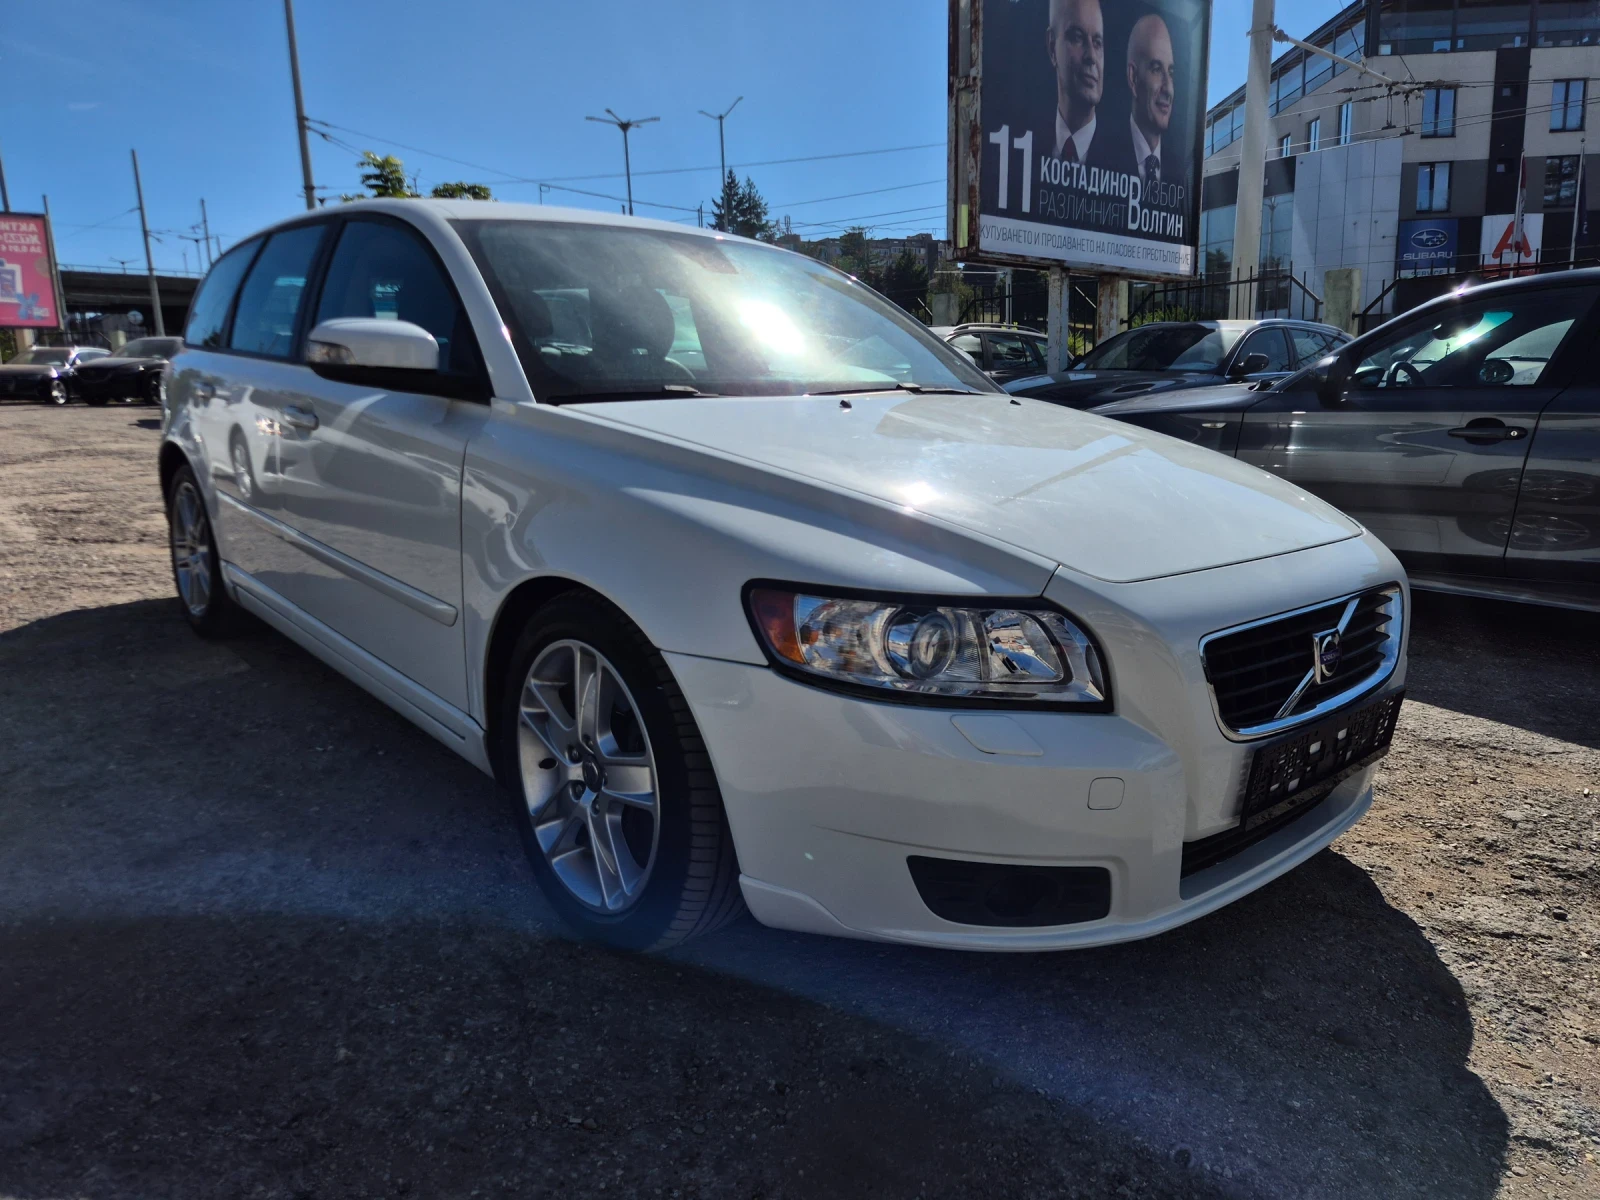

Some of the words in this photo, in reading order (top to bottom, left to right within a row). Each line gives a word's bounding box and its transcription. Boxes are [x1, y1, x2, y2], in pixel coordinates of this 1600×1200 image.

[989, 124, 1033, 213] 11
[1039, 189, 1127, 229] РАЗЛИЧНИЯТ
[1142, 180, 1185, 208] ИЗБОР
[980, 224, 1033, 245] КУПУВАНЕТО
[1034, 231, 1041, 246] И
[1042, 232, 1095, 253] ПРОДАВАНЕТО
[1096, 240, 1105, 253] НА
[1106, 241, 1136, 258] ГЛАСОВЕ
[1142, 247, 1191, 266] ПРЕСТЪПЛЕНИЕ
[1403, 251, 1453, 260] SUBARU
